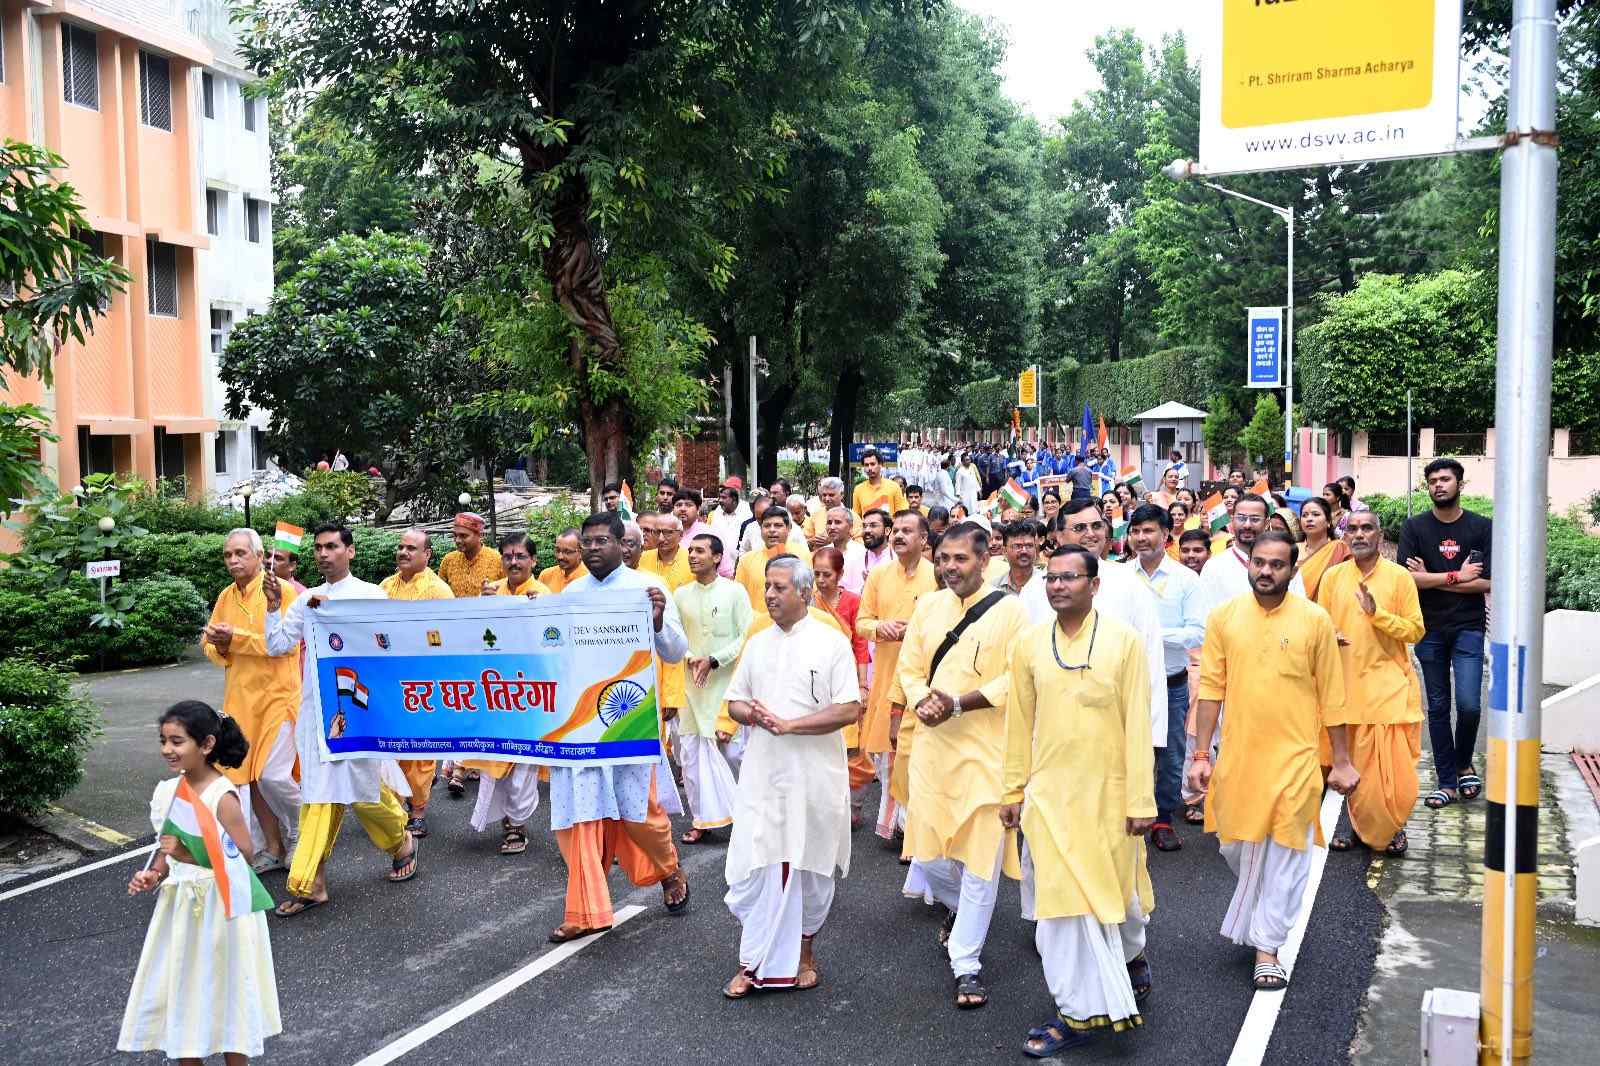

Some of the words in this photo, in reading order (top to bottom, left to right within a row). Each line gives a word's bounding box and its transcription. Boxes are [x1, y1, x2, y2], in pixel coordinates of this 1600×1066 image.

[1248, 75, 1263, 87] Pt.
[1267, 71, 1313, 85] Shriram
[1316, 65, 1361, 80] Sharma
[1364, 59, 1415, 74] Acharya
[1245, 124, 1405, 153] www.dsvv.ac.in
[573, 625, 591, 635] DEV
[592, 624, 640, 635] SANSKRITI
[574, 636, 641, 647] VISHWAVIDYALAYA
[400, 680, 435, 713] हर
[439, 680, 479, 713] घर
[480, 667, 559, 714] तिरंगा
